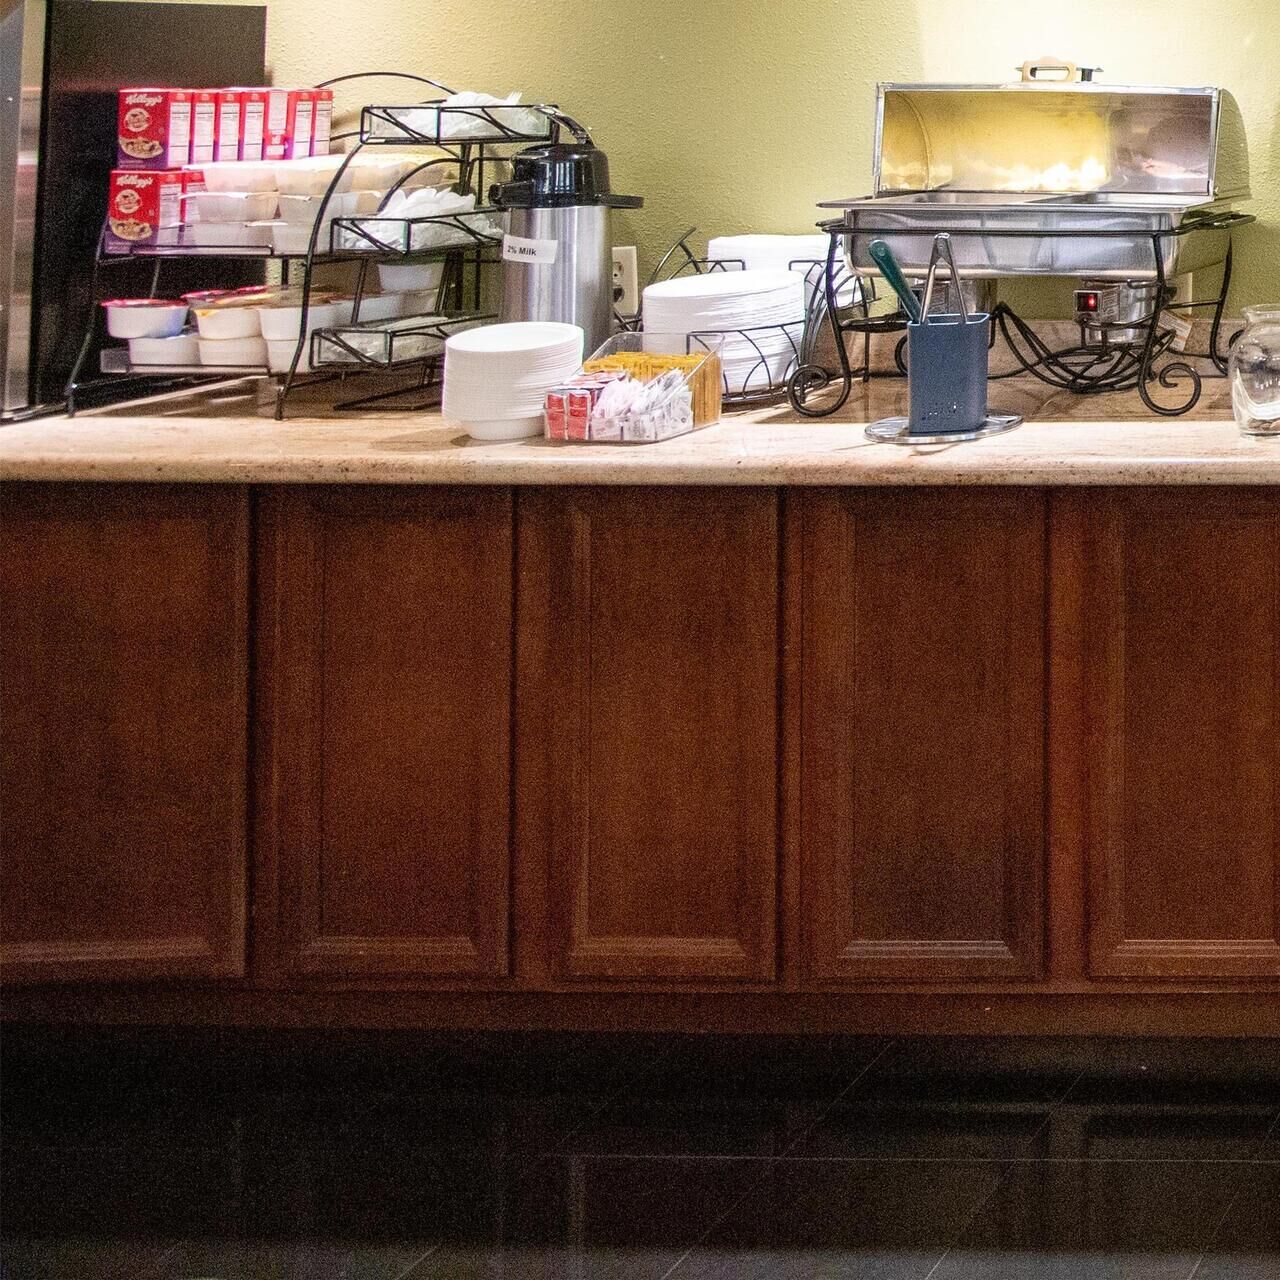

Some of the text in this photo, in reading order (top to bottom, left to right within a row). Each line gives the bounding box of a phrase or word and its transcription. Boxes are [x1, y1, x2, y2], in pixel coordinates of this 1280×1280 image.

[125, 93, 163, 107] Kellogg's
[116, 174, 154, 188] Kellogg's
[507, 244, 537, 256] 2% Milk
